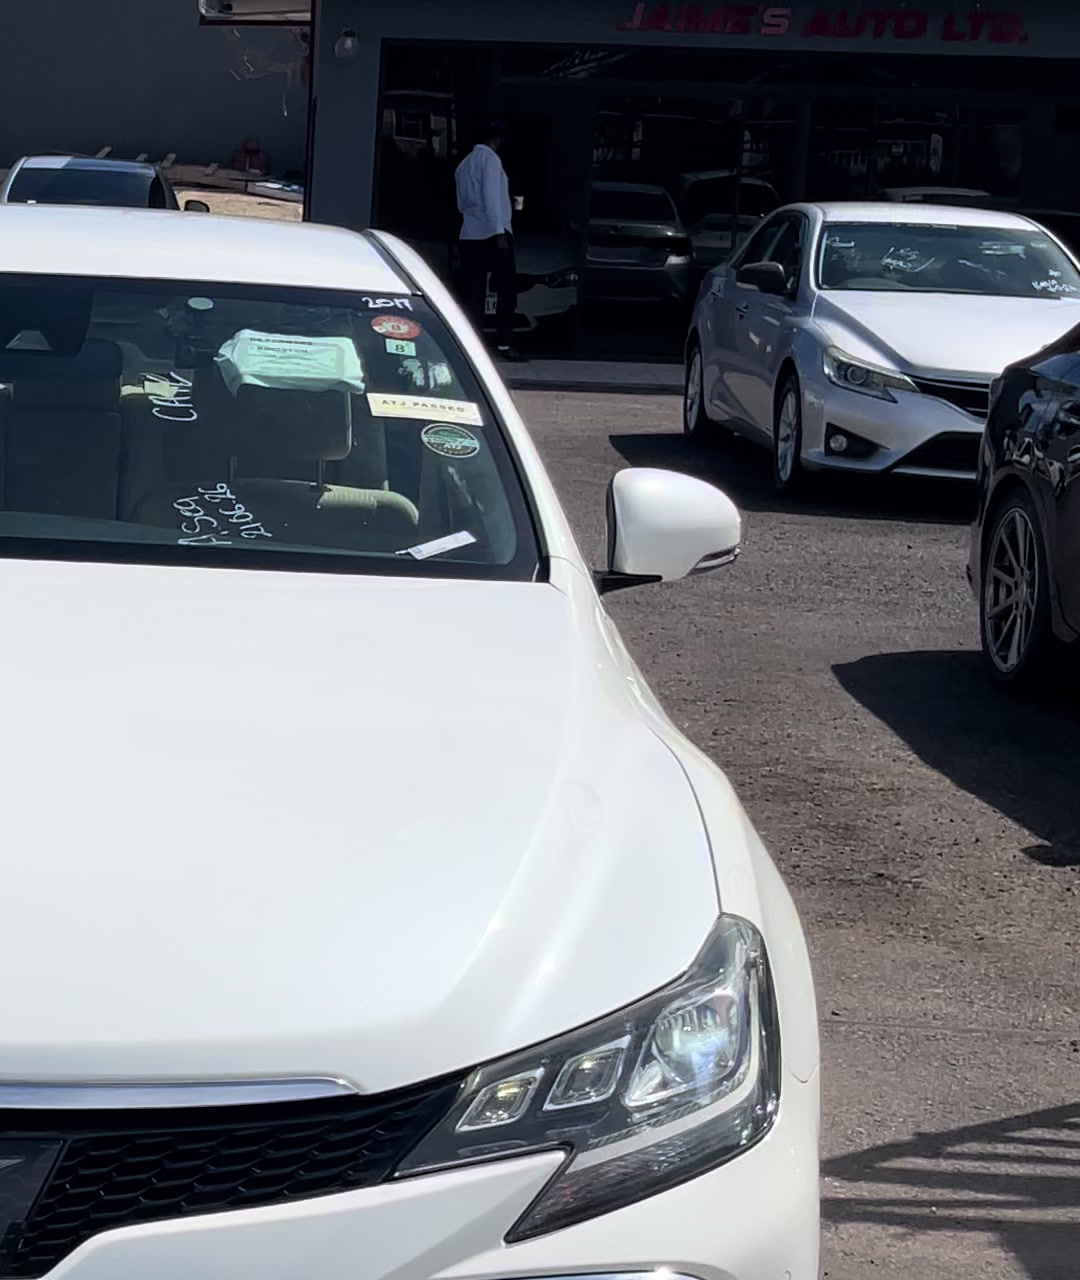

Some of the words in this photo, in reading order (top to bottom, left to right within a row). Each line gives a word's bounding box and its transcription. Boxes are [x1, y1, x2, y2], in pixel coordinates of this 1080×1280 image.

[801, 8, 928, 41] AUTO
[395, 344, 405, 353] 8
[413, 401, 465, 413] PASSED
